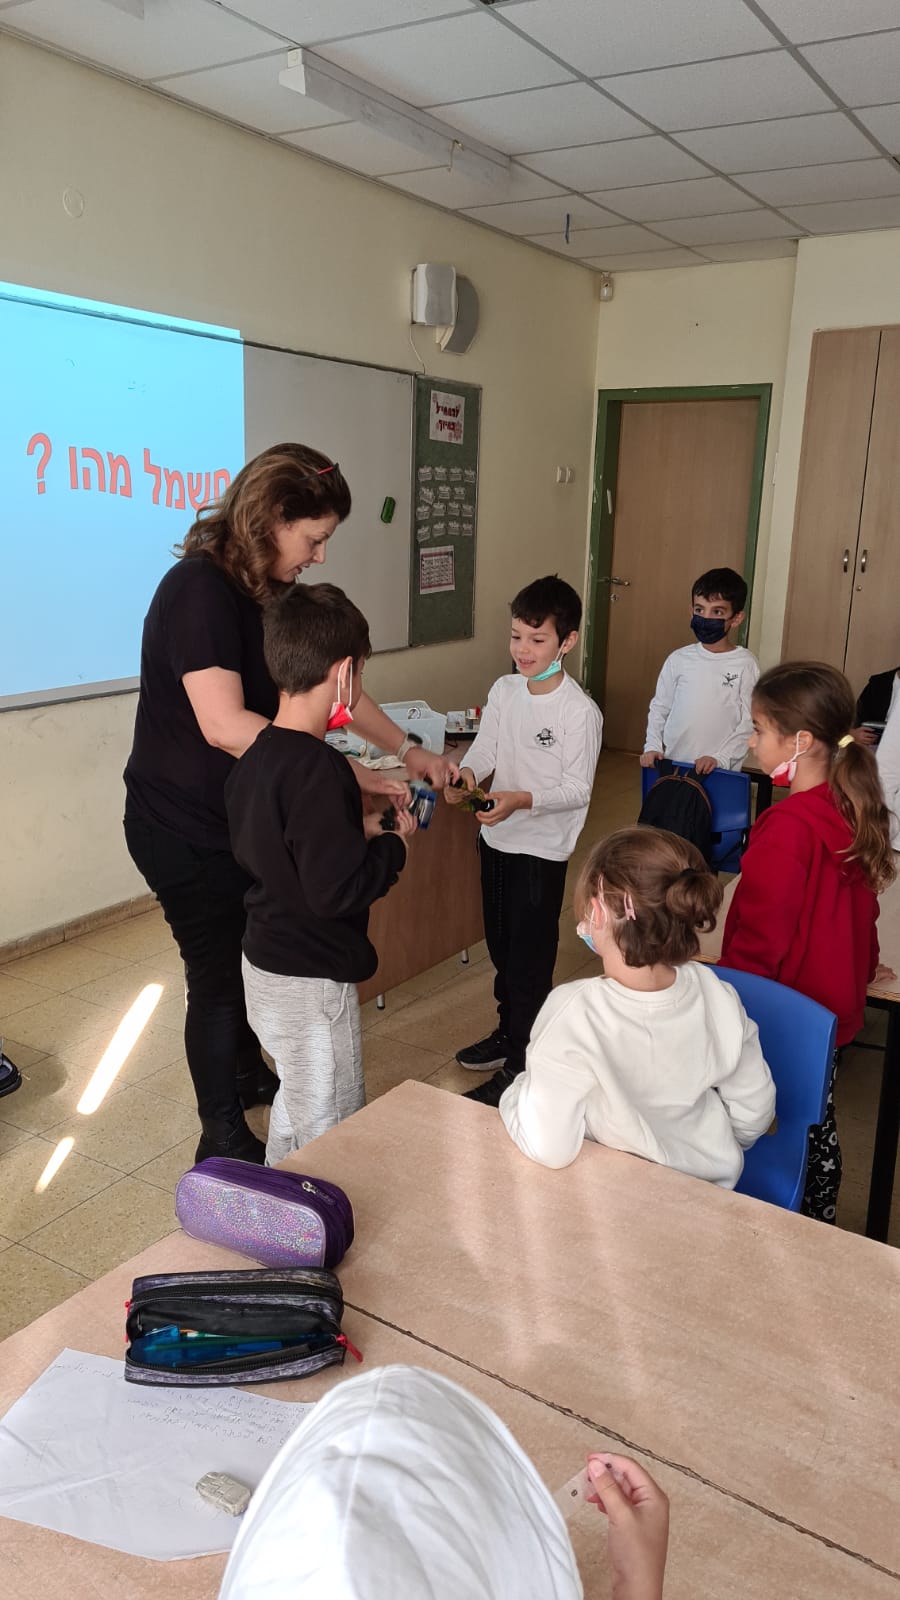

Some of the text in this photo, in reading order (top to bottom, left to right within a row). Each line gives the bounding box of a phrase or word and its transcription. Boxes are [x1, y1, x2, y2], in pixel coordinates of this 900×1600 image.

[27, 432, 231, 510] חשמל מהו ?
